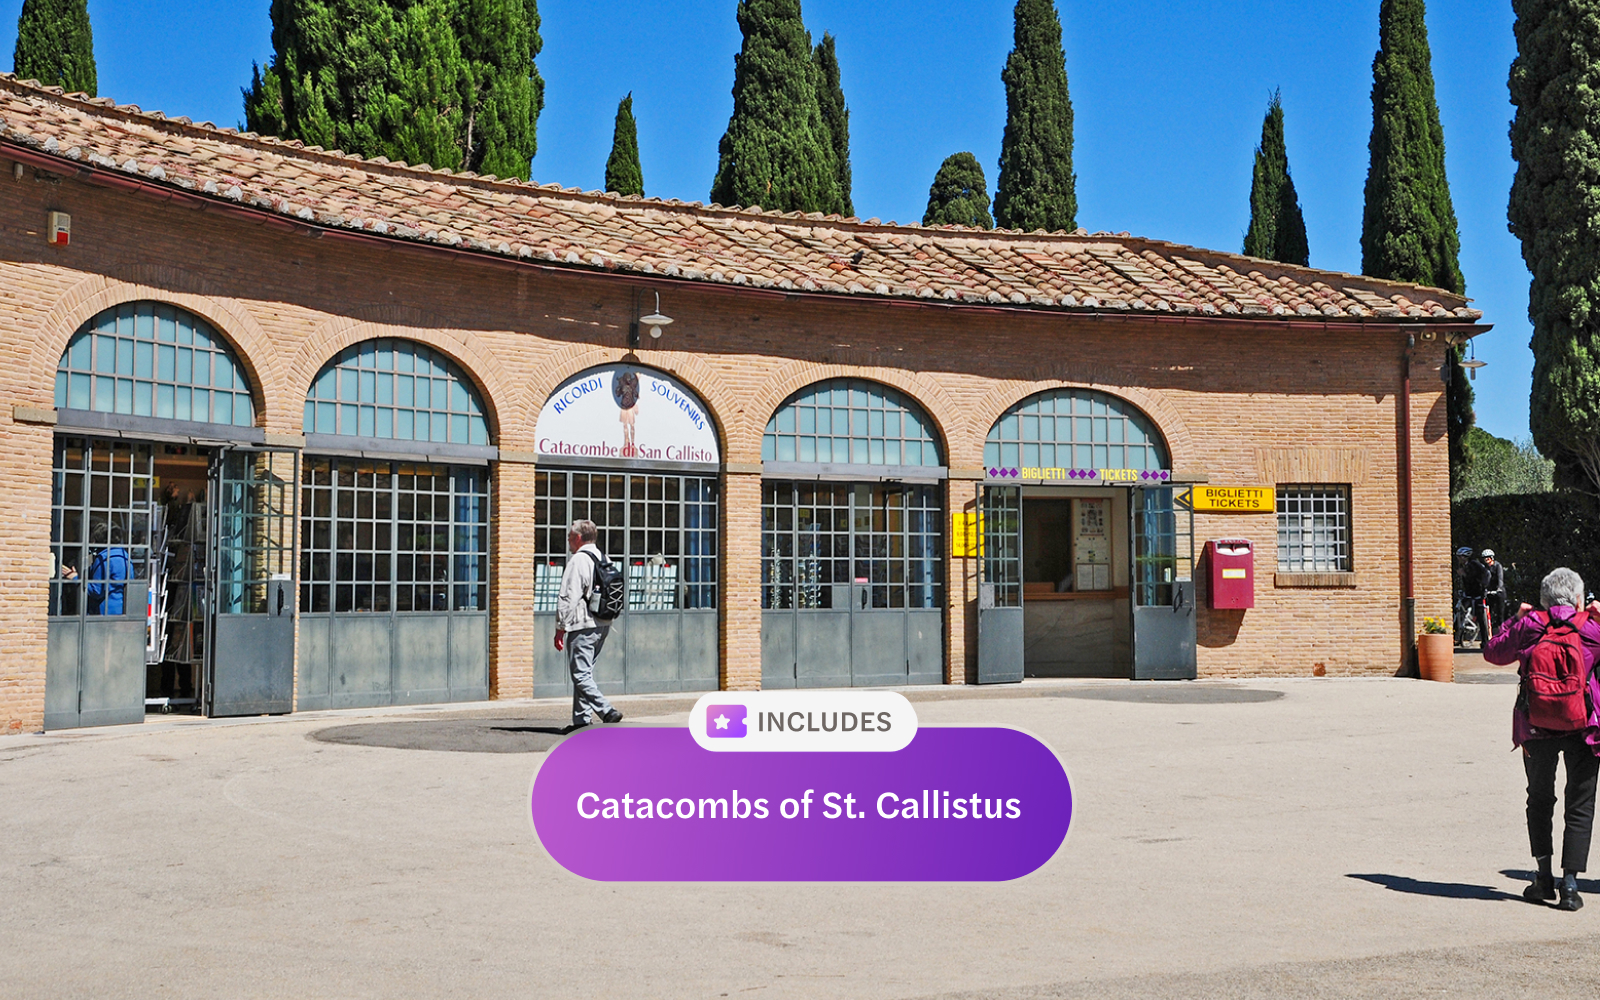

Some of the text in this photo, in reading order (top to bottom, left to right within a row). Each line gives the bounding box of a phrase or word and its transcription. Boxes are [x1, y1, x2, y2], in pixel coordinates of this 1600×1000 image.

[553, 377, 705, 431] RICORDI SOUVENIRS
[539, 437, 713, 462] Catacombe di San Callisto
[1021, 467, 1138, 481] BIGLIETTI TICKETS
[1206, 489, 1263, 498] BIGLIETTI
[1209, 498, 1260, 508] TICKETS
